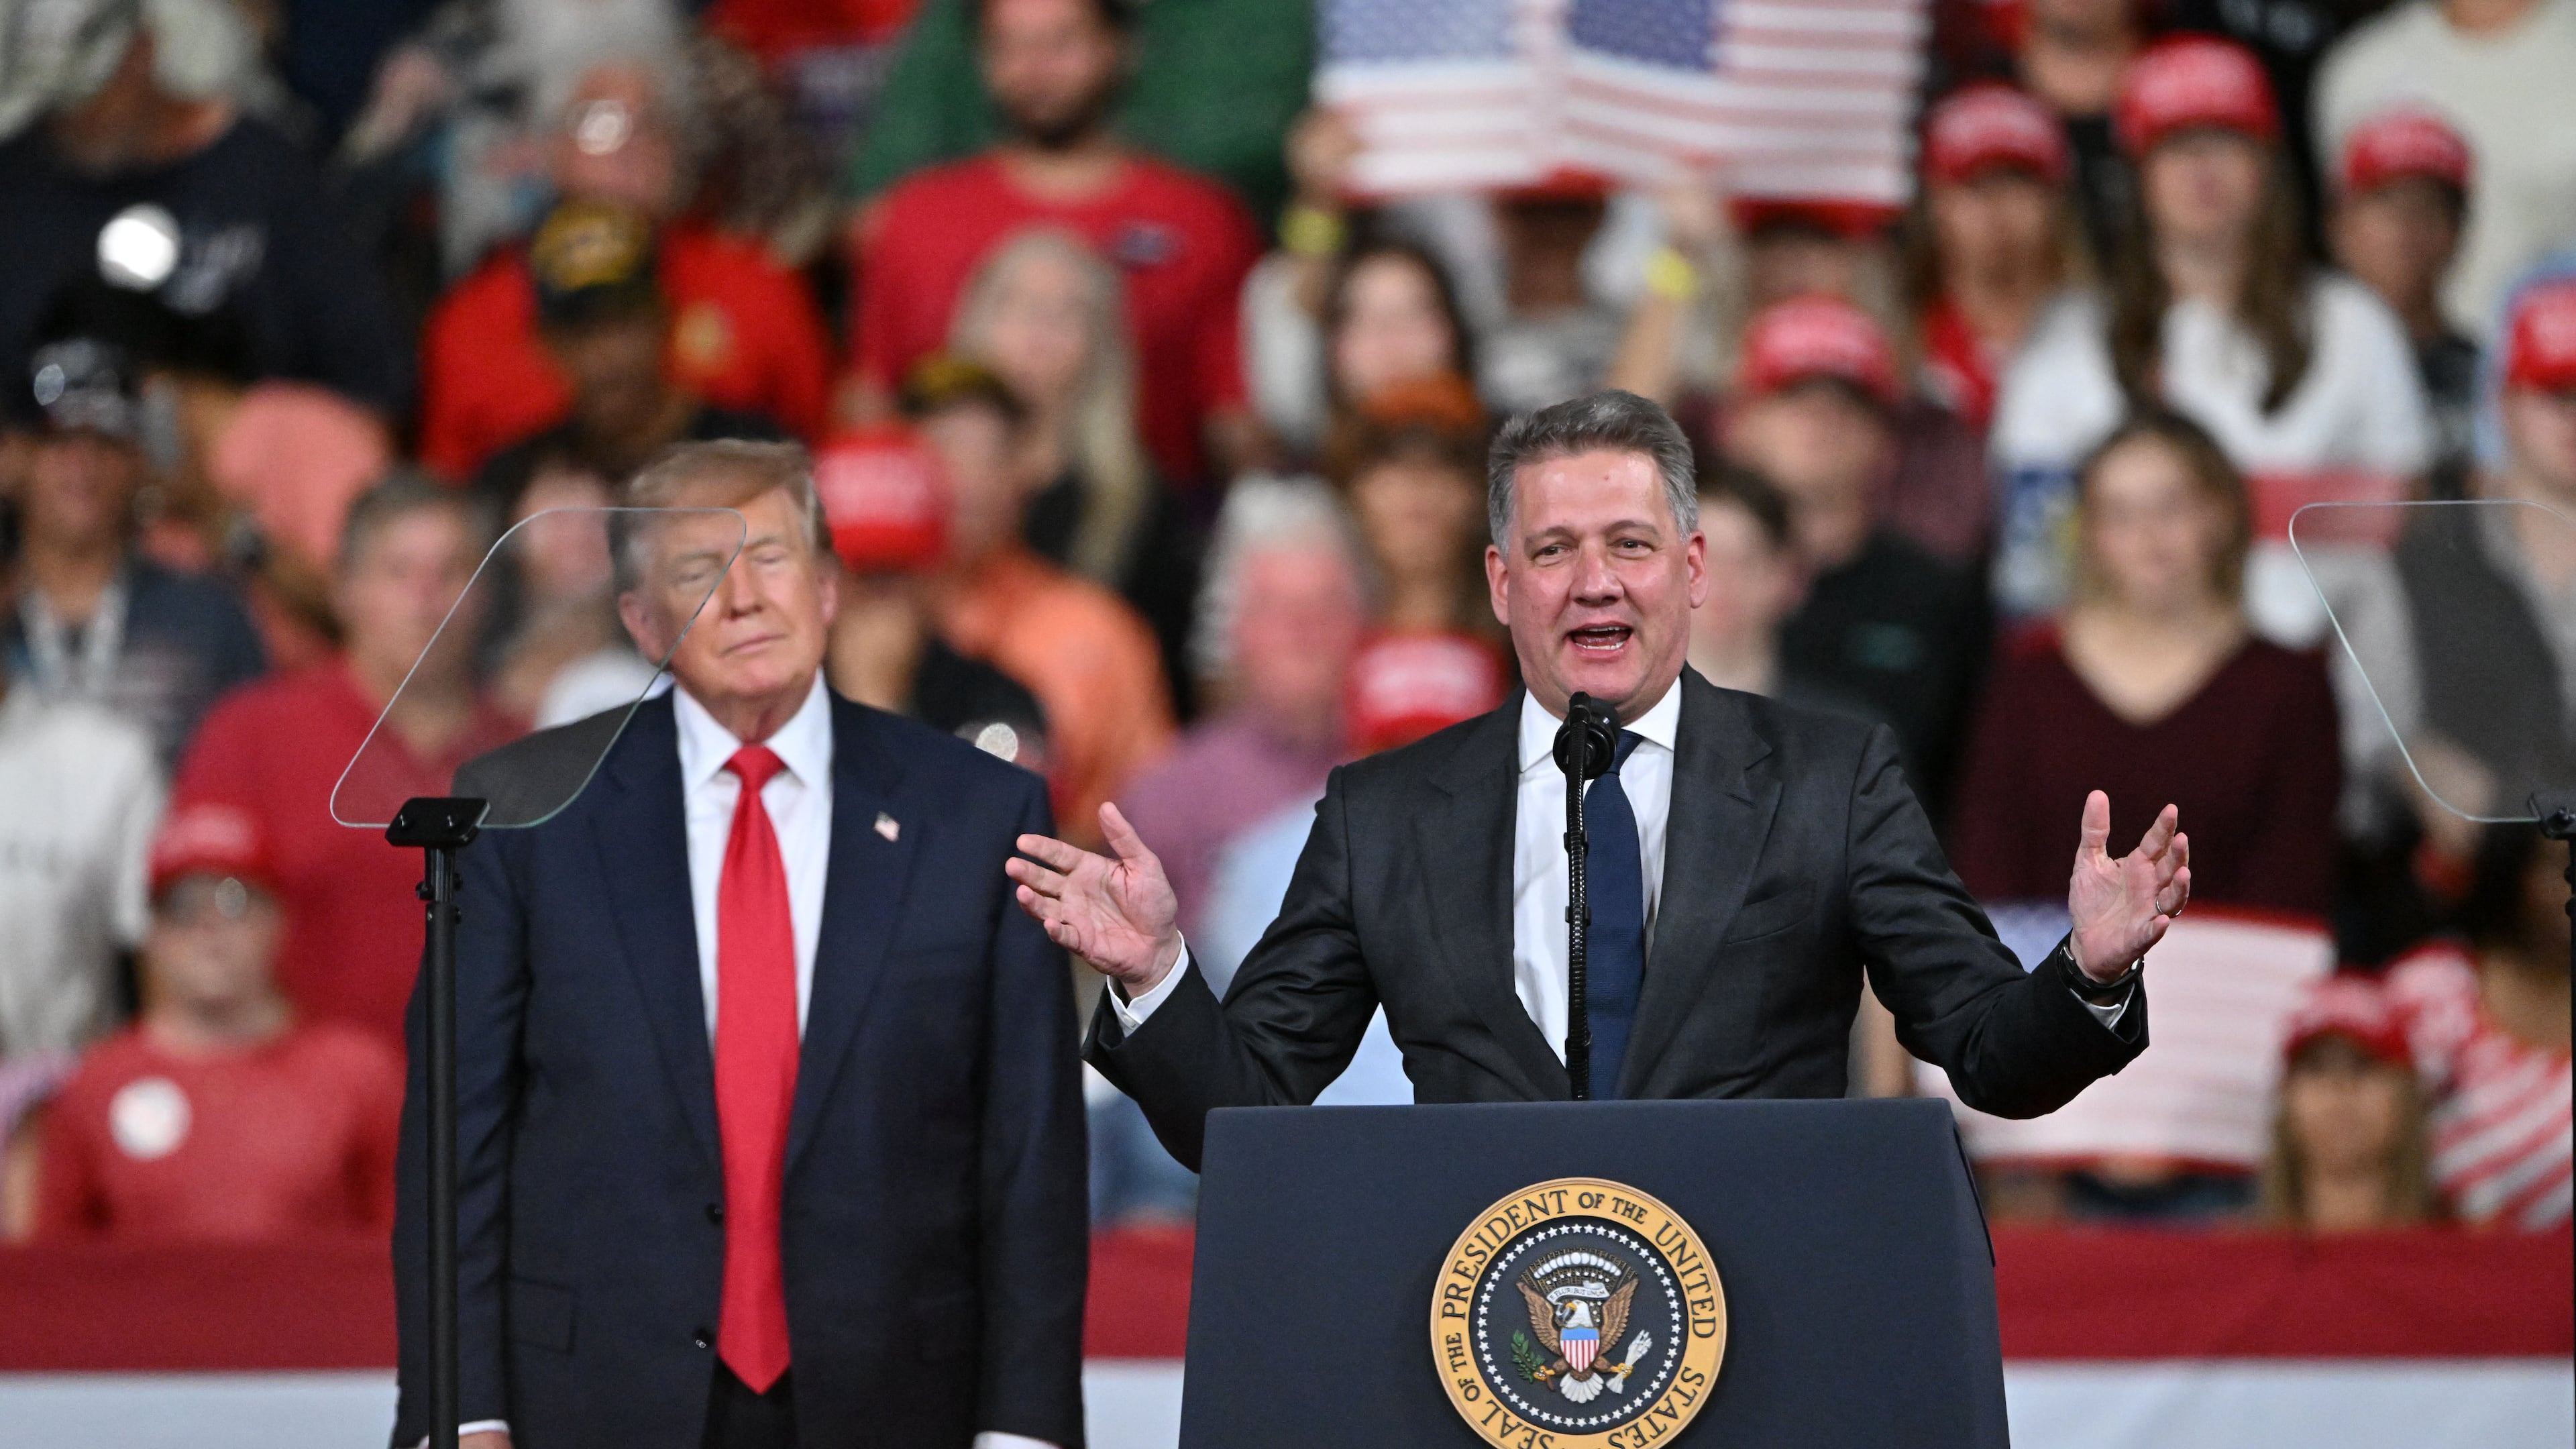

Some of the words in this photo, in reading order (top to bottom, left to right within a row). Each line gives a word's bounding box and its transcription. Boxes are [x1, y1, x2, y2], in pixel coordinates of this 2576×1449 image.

[1578, 1191, 1605, 1209] OF
[1611, 1197, 1648, 1224] THE
[1442, 1189, 1568, 1320] PRESIDENT
[1655, 1220, 1716, 1338] UNITED
[1446, 1332, 1467, 1373] THE
[1457, 1378, 1481, 1401] OF
[1608, 1366, 1705, 1449] STATES
[1481, 1399, 1554, 1449] SEAL
